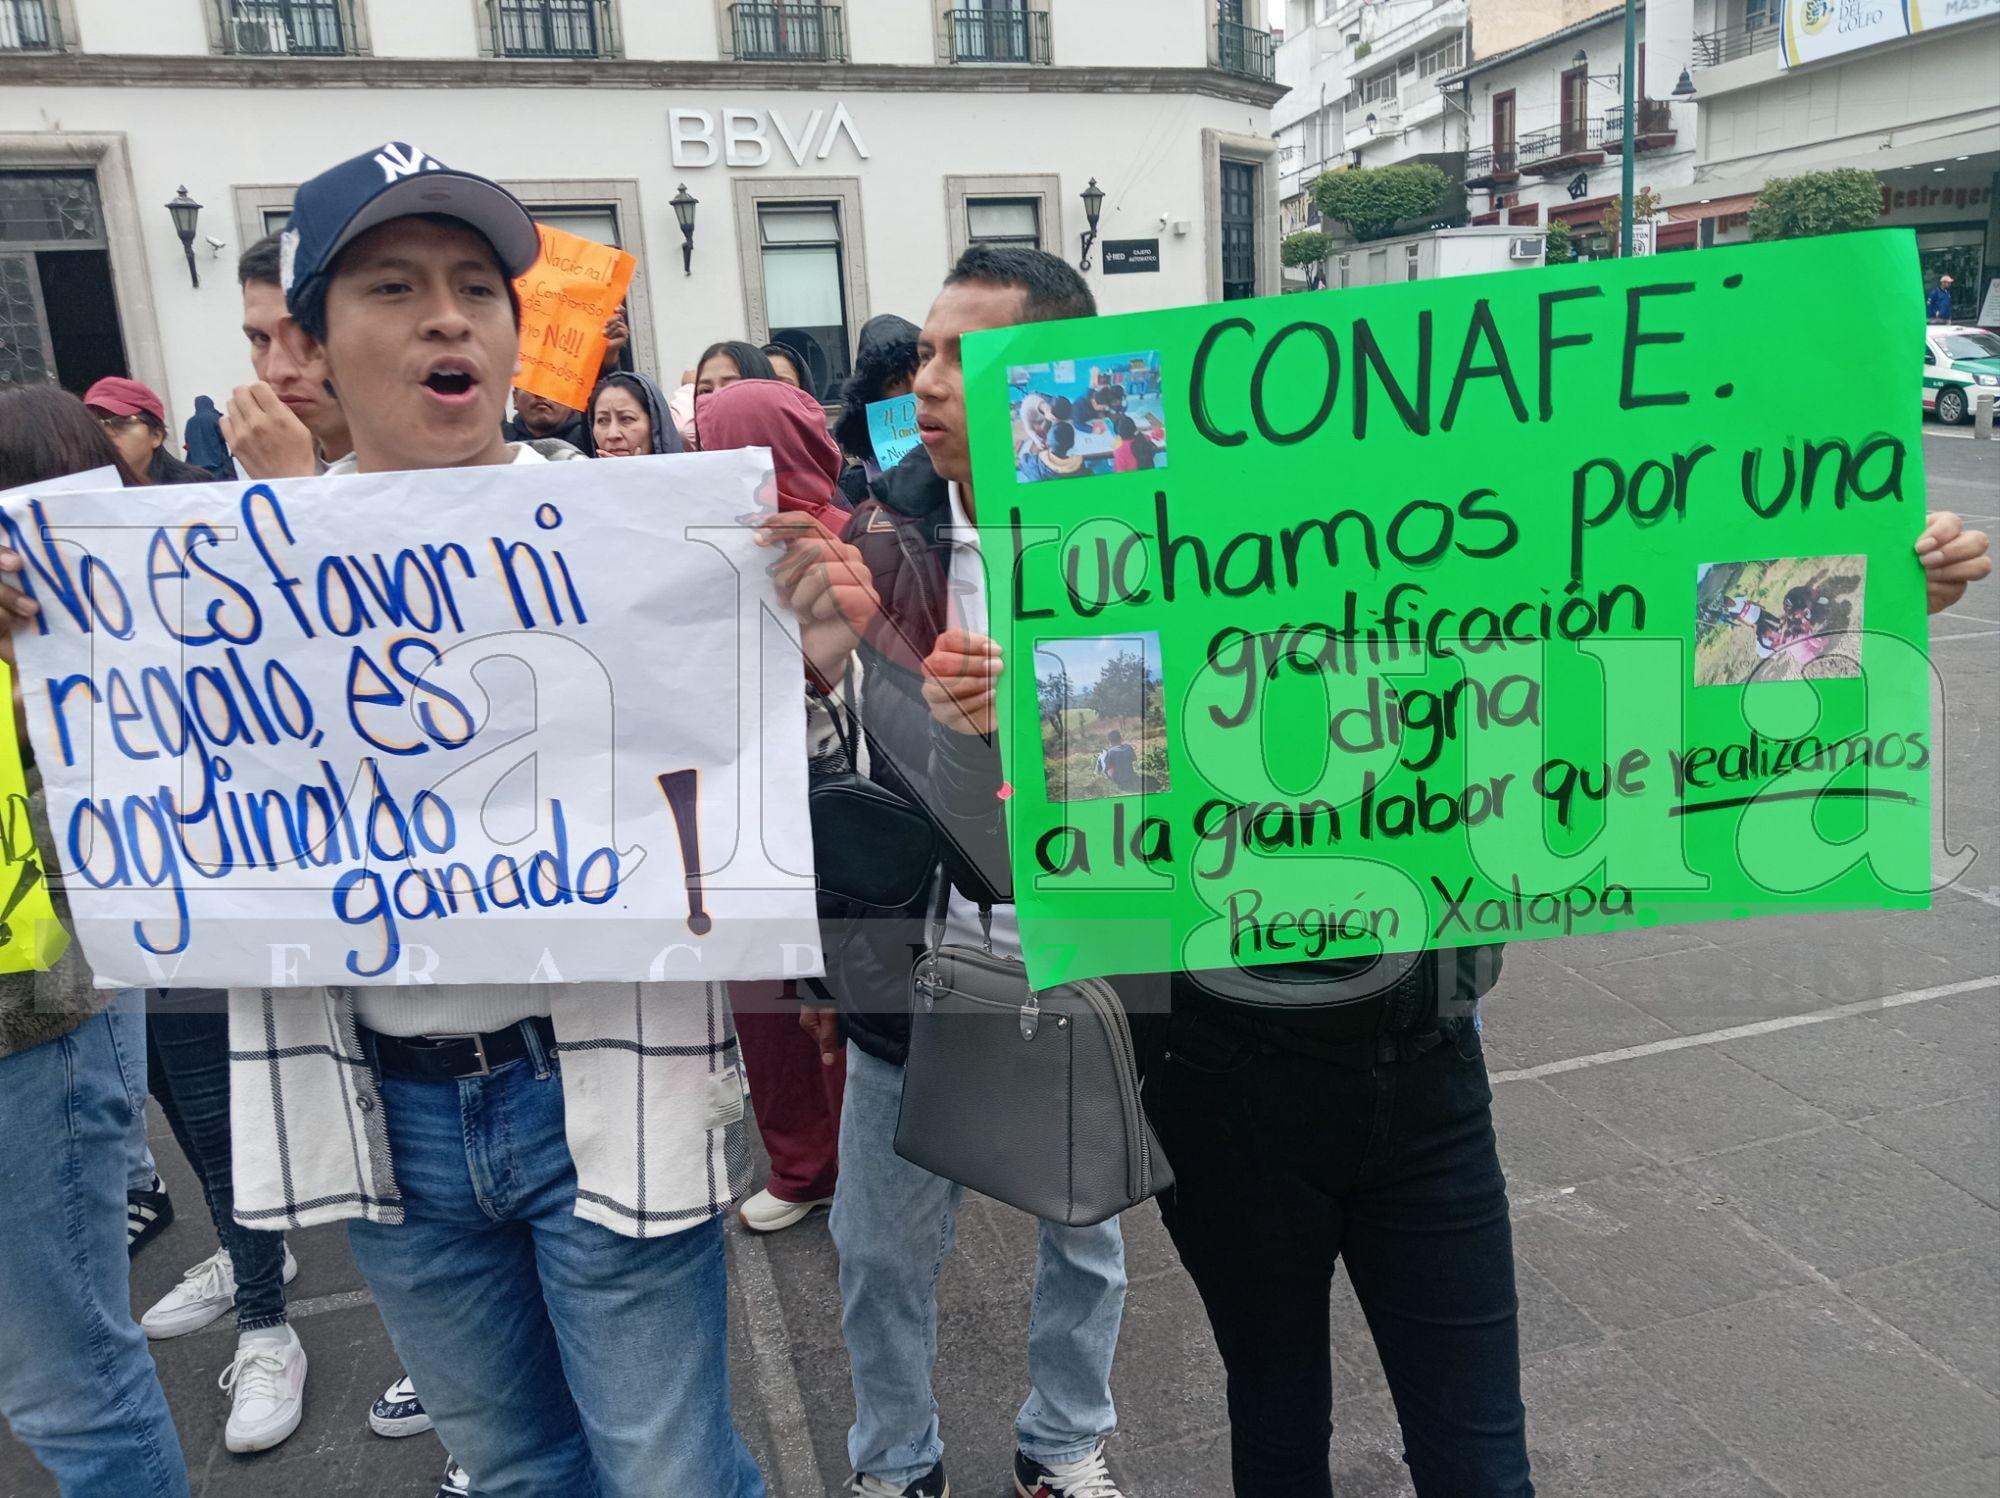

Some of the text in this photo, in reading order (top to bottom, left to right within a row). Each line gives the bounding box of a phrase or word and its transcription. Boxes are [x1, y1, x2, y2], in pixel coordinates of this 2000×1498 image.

[1838, 9, 1883, 33] GOLFO
[667, 101, 871, 168] BBVA
[0, 483, 589, 647] No es favor ni
[1570, 440, 1718, 583] por
[1741, 431, 1907, 520] una
[347, 636, 476, 757] es
[1207, 580, 1647, 729] gratificación
[1330, 673, 1541, 773] digna
[1035, 728, 1930, 880] a la gran labor que realizamos
[1223, 873, 1635, 959] Región Xalapa
